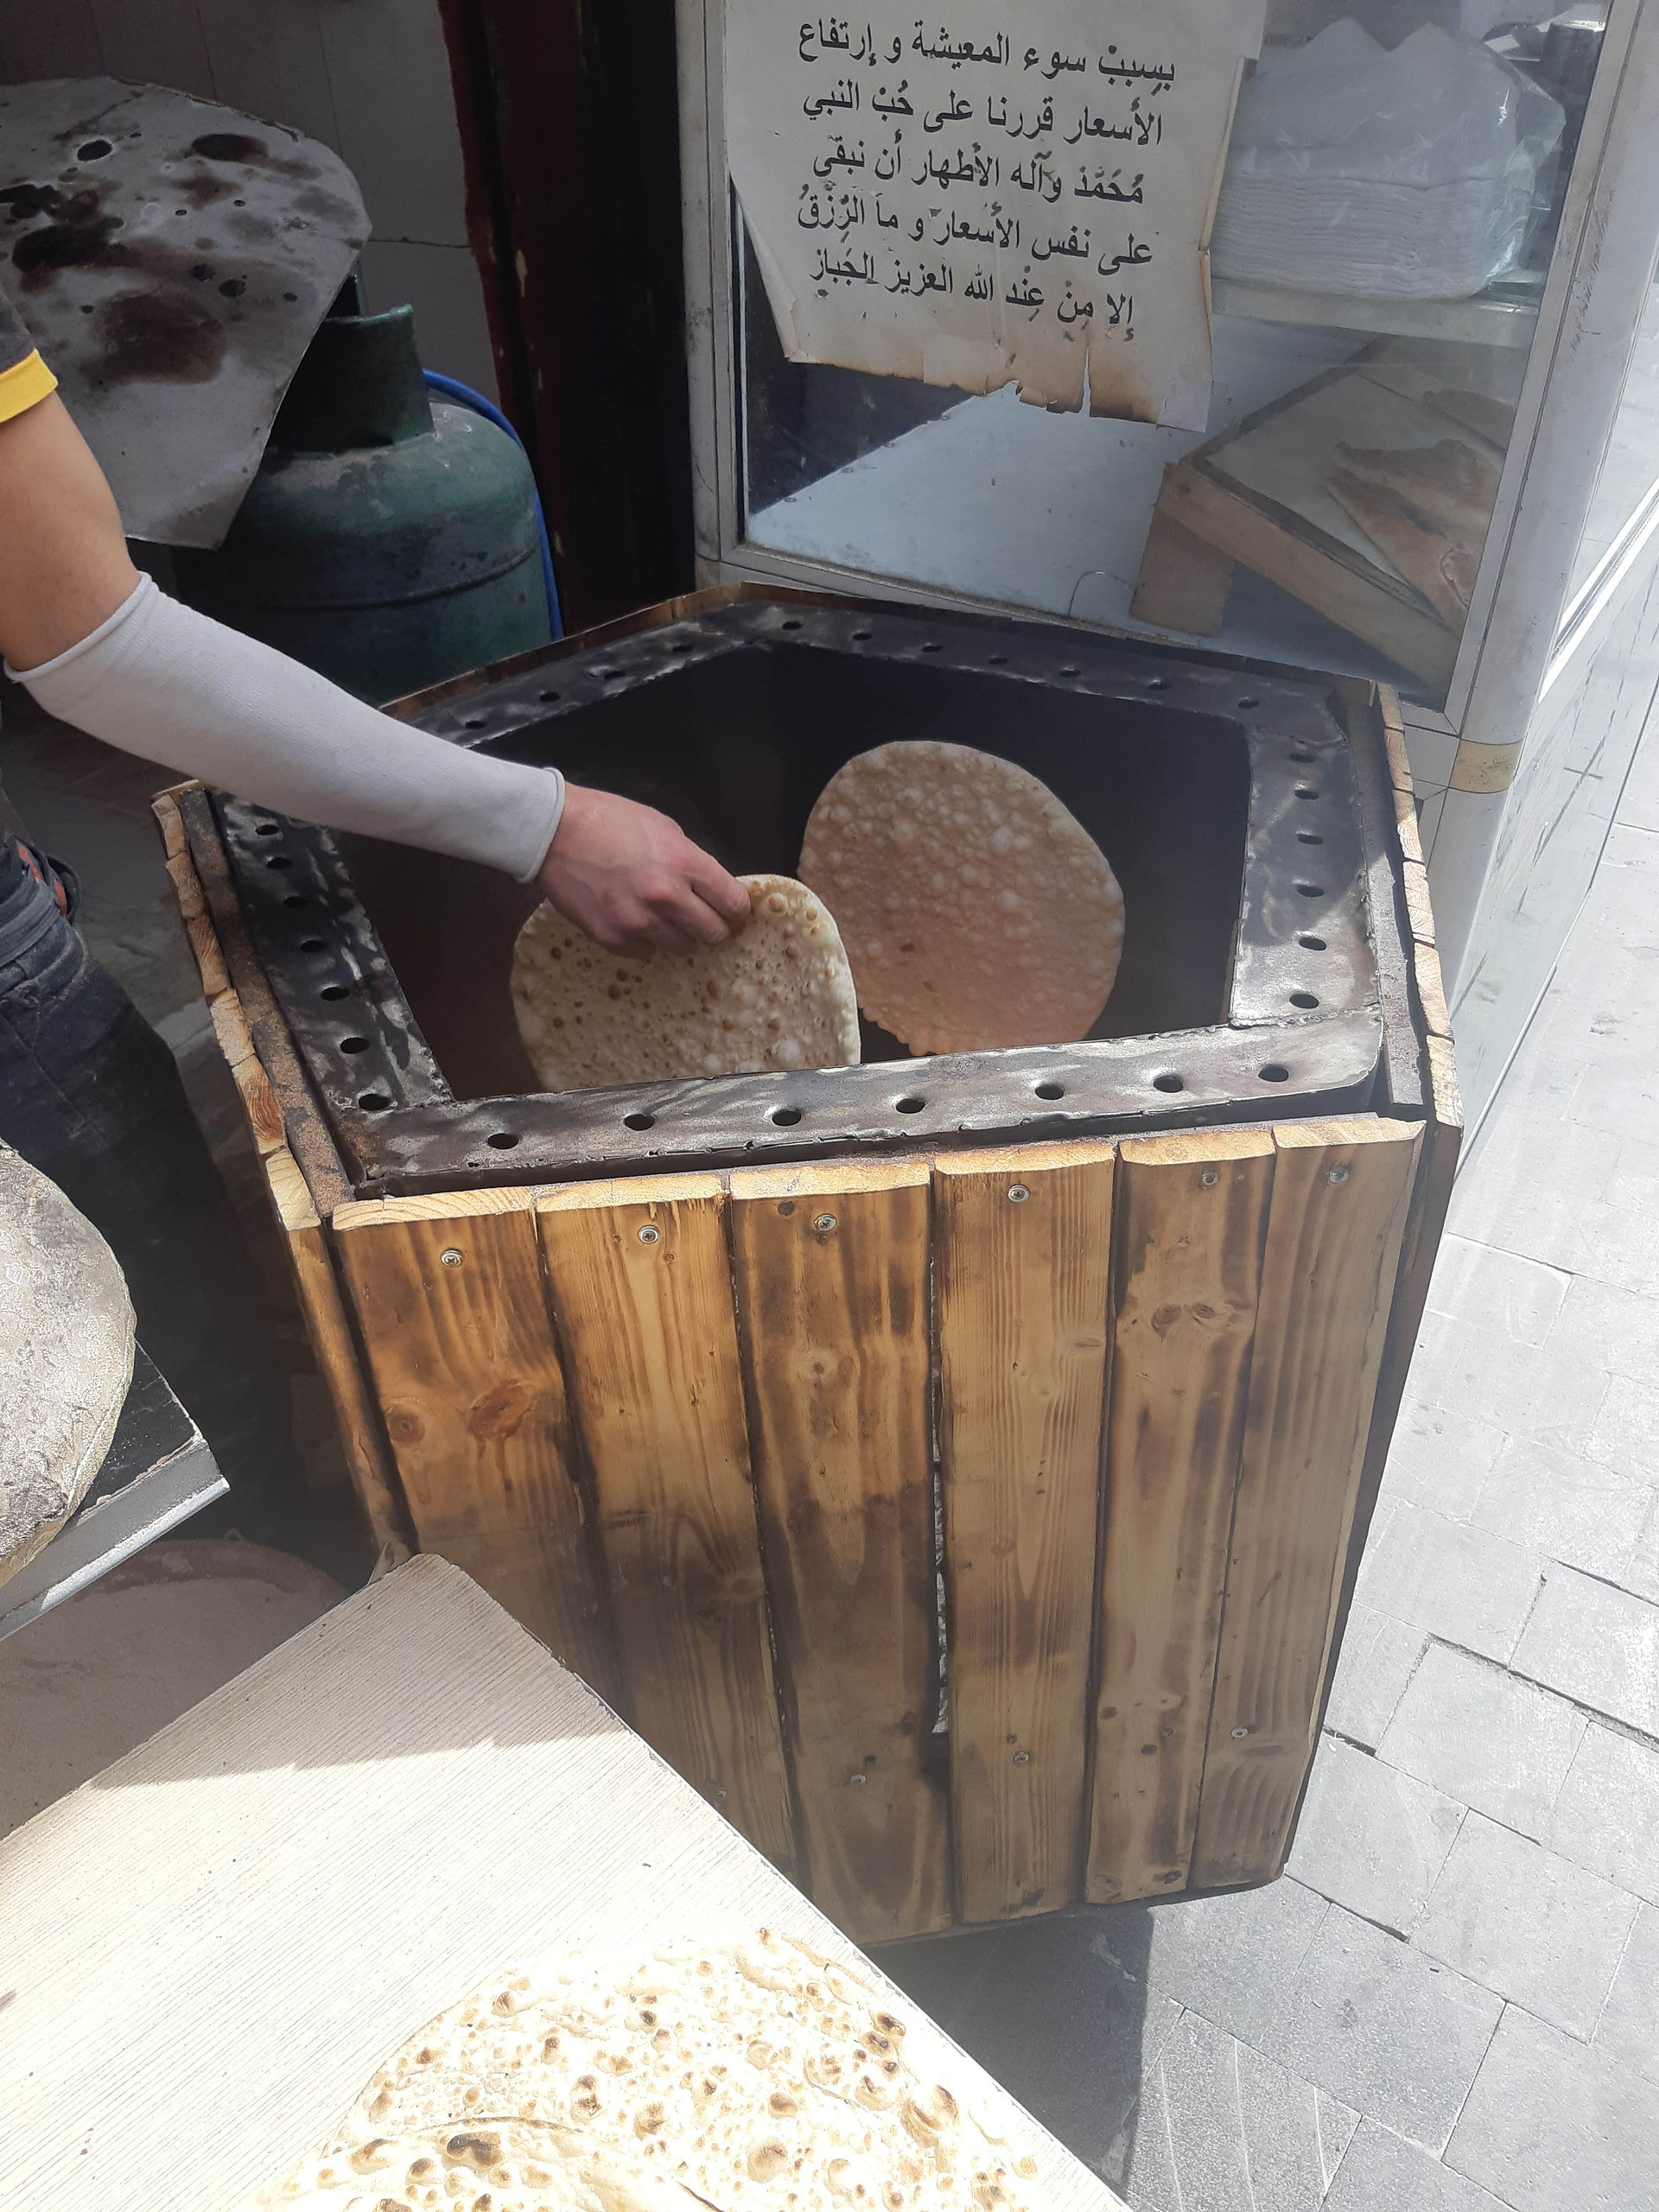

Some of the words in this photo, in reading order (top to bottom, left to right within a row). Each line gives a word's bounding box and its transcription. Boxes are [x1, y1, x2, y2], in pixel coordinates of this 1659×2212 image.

[799, 17, 877, 67] إرتفاع
[884, 36, 901, 64] و
[912, 19, 1009, 69] المعيشة
[1024, 48, 1086, 79] سوء
[803, 79, 860, 121] النبي
[923, 89, 974, 132] على
[988, 95, 1053, 139] قررنا
[1063, 96, 1162, 145] الأسعار
[813, 135, 865, 177] نبقى
[874, 129, 902, 180] أن
[911, 142, 1000, 189] الأطهار
[908, 217, 924, 241] و
[932, 200, 1020, 248] الأسعار
[1031, 226, 1091, 260] نفس
[1097, 232, 1154, 276] على
[884, 258, 953, 297] العزيز
[963, 264, 994, 302] الله
[1106, 292, 1135, 341] إلا
